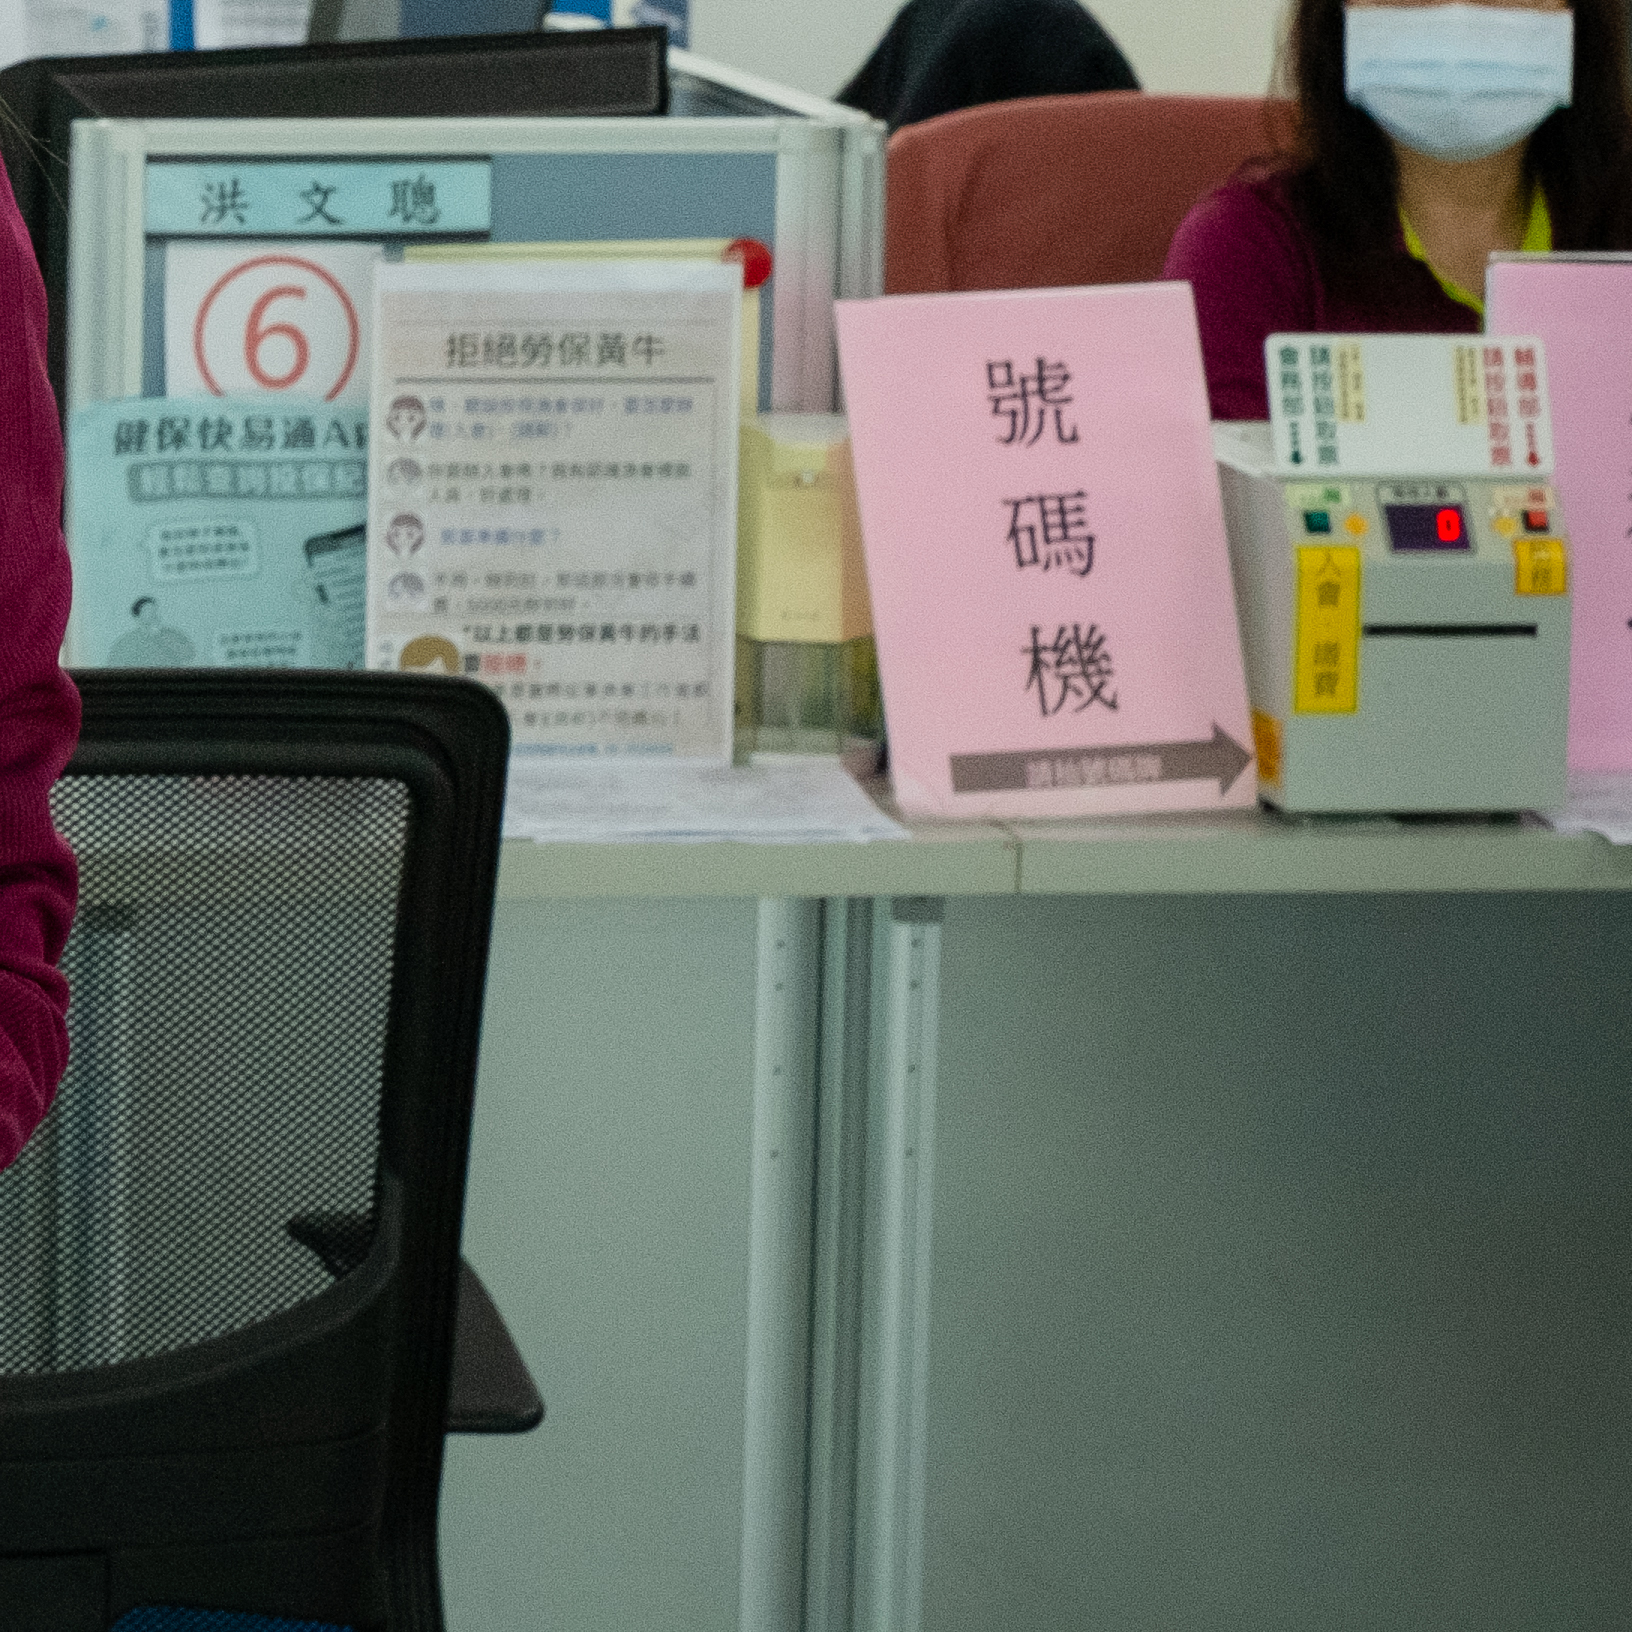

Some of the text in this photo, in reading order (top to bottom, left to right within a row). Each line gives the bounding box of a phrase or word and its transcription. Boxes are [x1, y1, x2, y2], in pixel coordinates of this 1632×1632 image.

[243, 284, 311, 391] 6
[985, 355, 1120, 718] 號碼機
